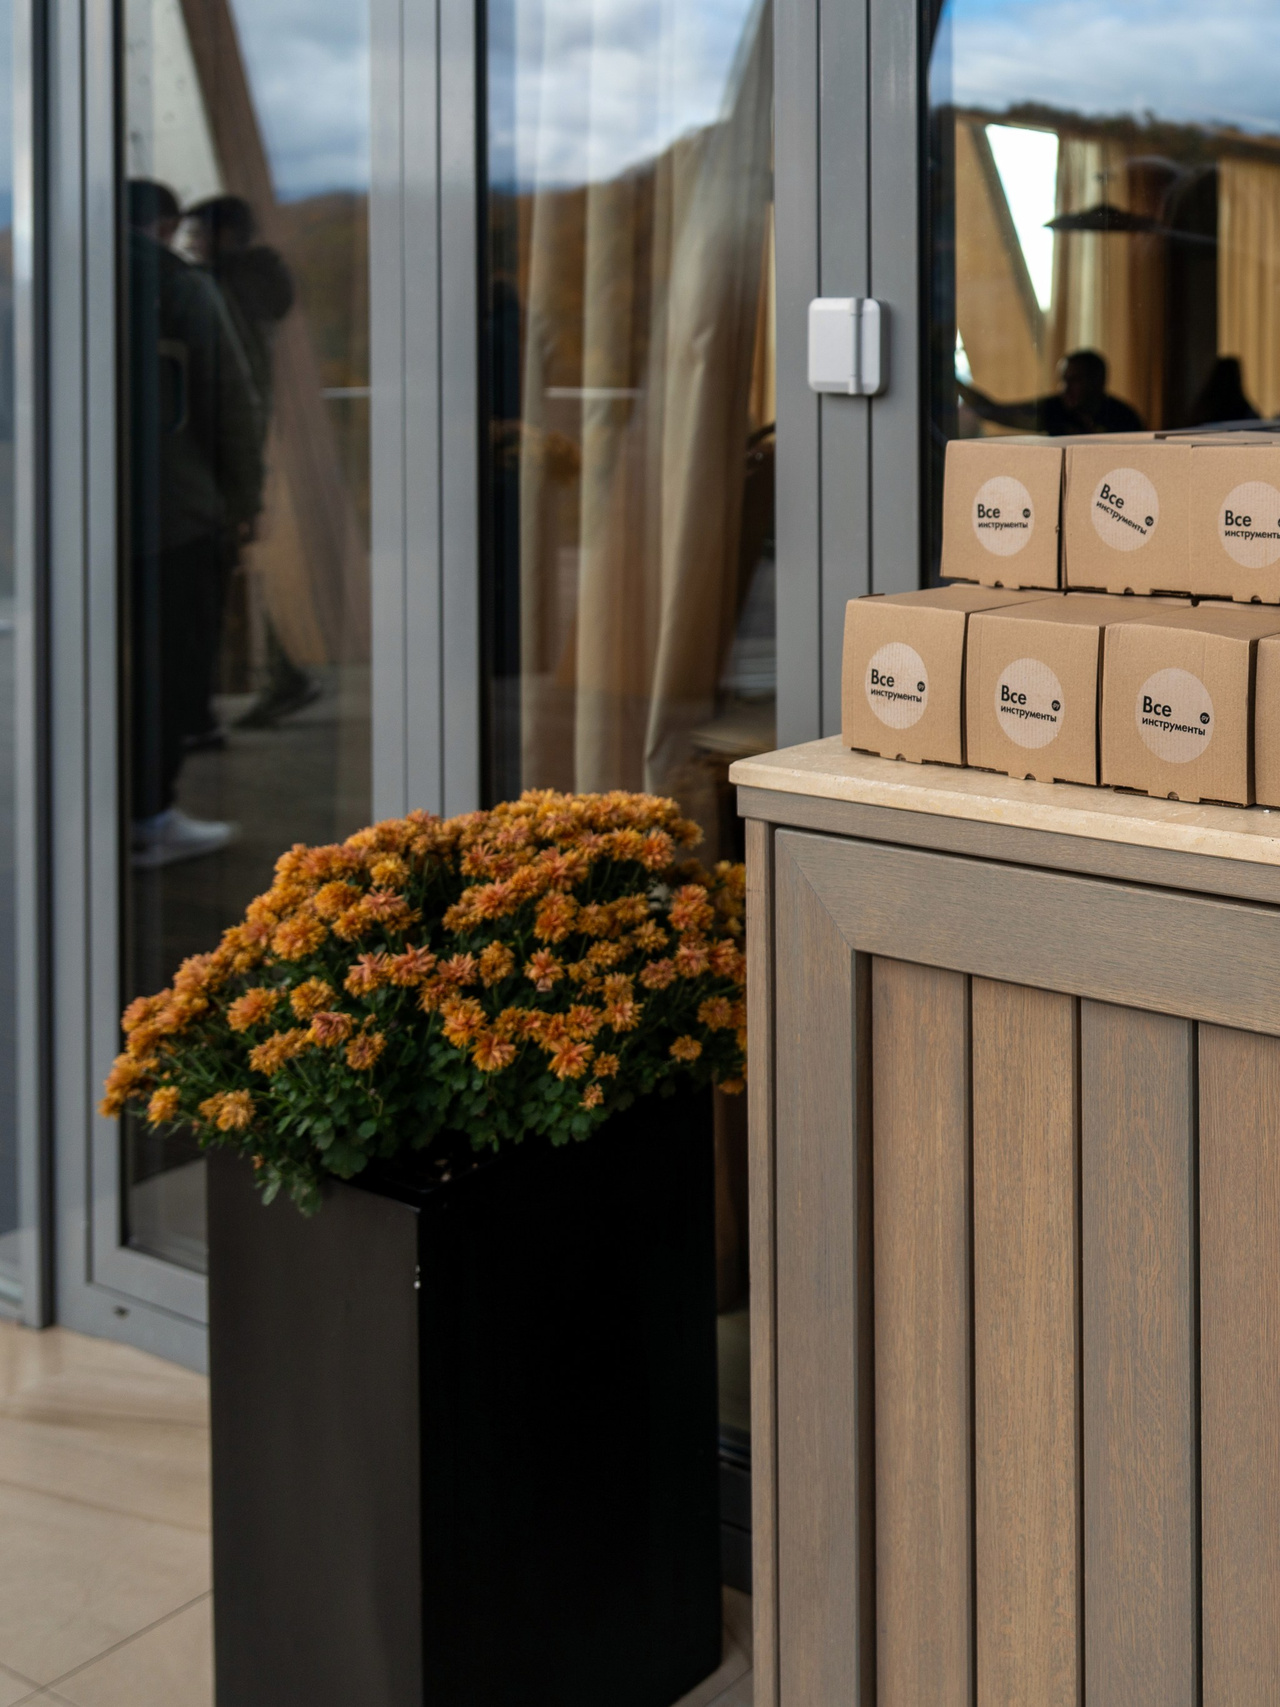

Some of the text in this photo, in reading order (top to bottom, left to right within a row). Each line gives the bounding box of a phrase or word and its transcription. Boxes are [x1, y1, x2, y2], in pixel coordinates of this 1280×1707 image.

[1099, 483, 1125, 509] Все
[977, 503, 1001, 519] Все
[1095, 500, 1148, 536] инструменты
[1224, 509, 1252, 528] Все
[977, 521, 1029, 531] инструменты
[870, 668, 895, 688] Все
[870, 689, 923, 704] инструменты
[1000, 684, 1027, 706] Все
[1000, 705, 1057, 723] инструменты
[1142, 695, 1172, 718] Все
[1141, 717, 1206, 736] инструменты
